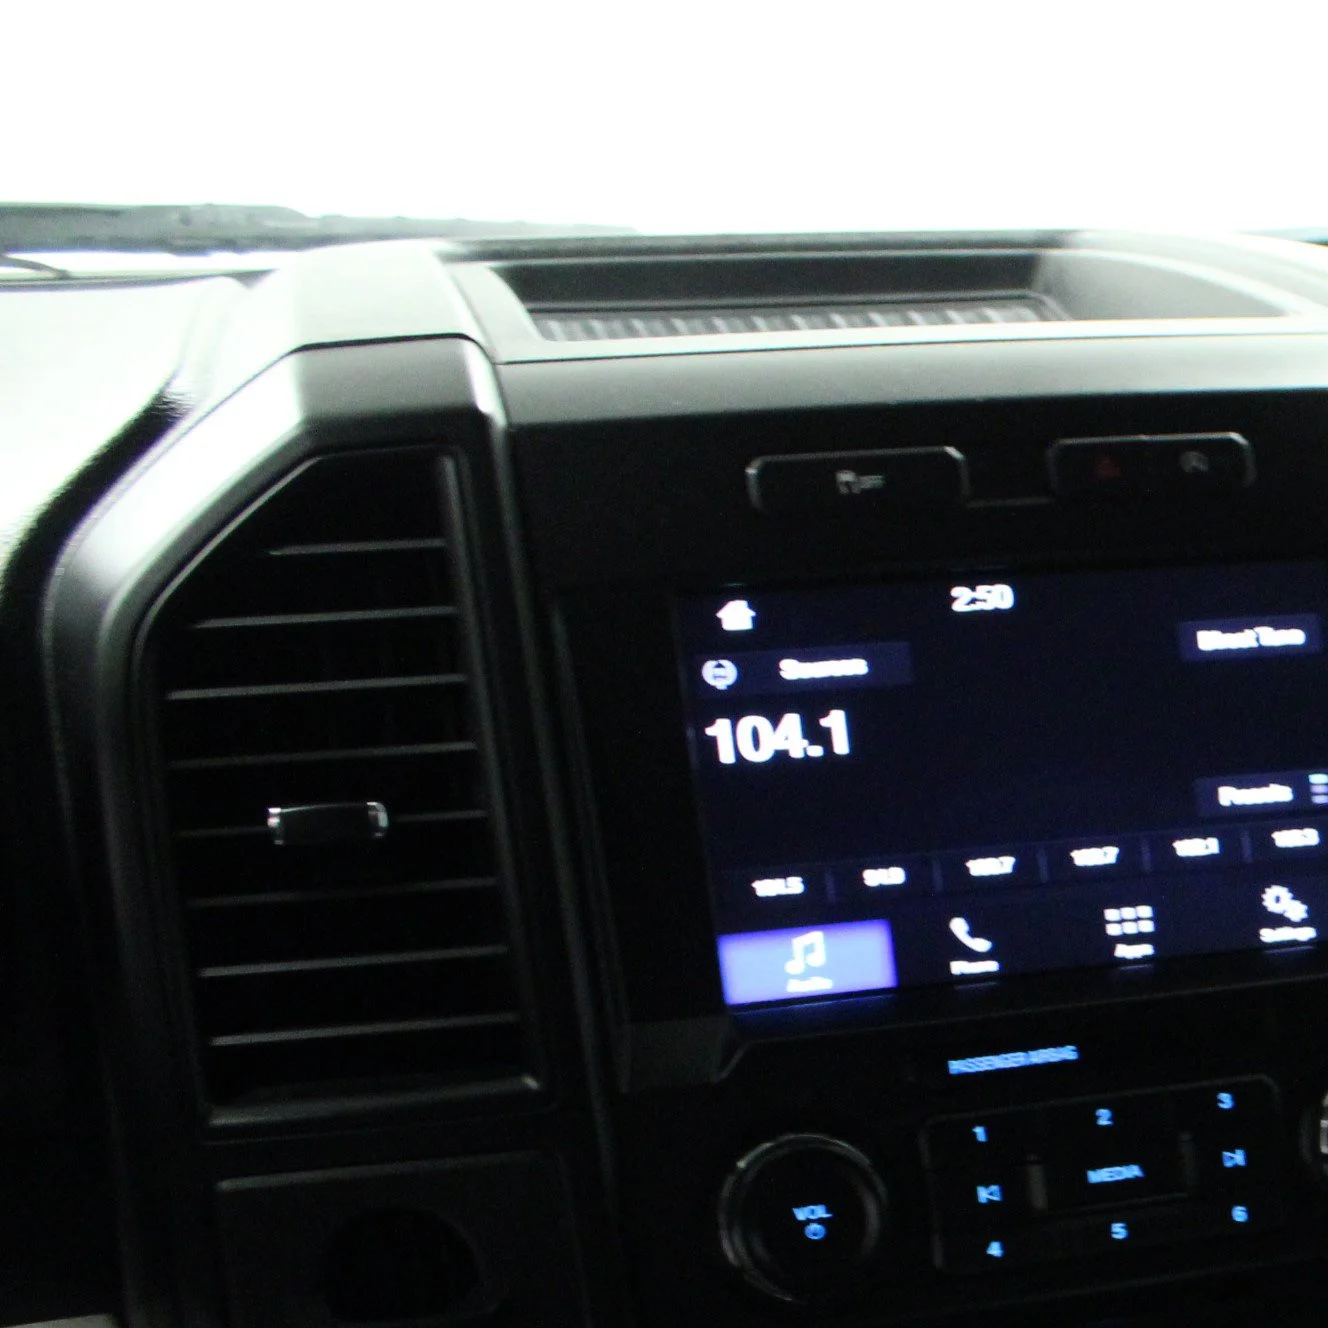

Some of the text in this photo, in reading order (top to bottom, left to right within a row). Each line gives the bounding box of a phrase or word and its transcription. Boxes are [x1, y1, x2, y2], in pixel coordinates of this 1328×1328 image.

[705, 709, 849, 764] 104.1
[1217, 1092, 1235, 1110] 3
[1095, 1108, 1114, 1126] 2
[972, 1125, 987, 1142] 1
[1231, 1205, 1249, 1223] 6
[1111, 1222, 1129, 1240] 5
[986, 1241, 1004, 1258] 4
